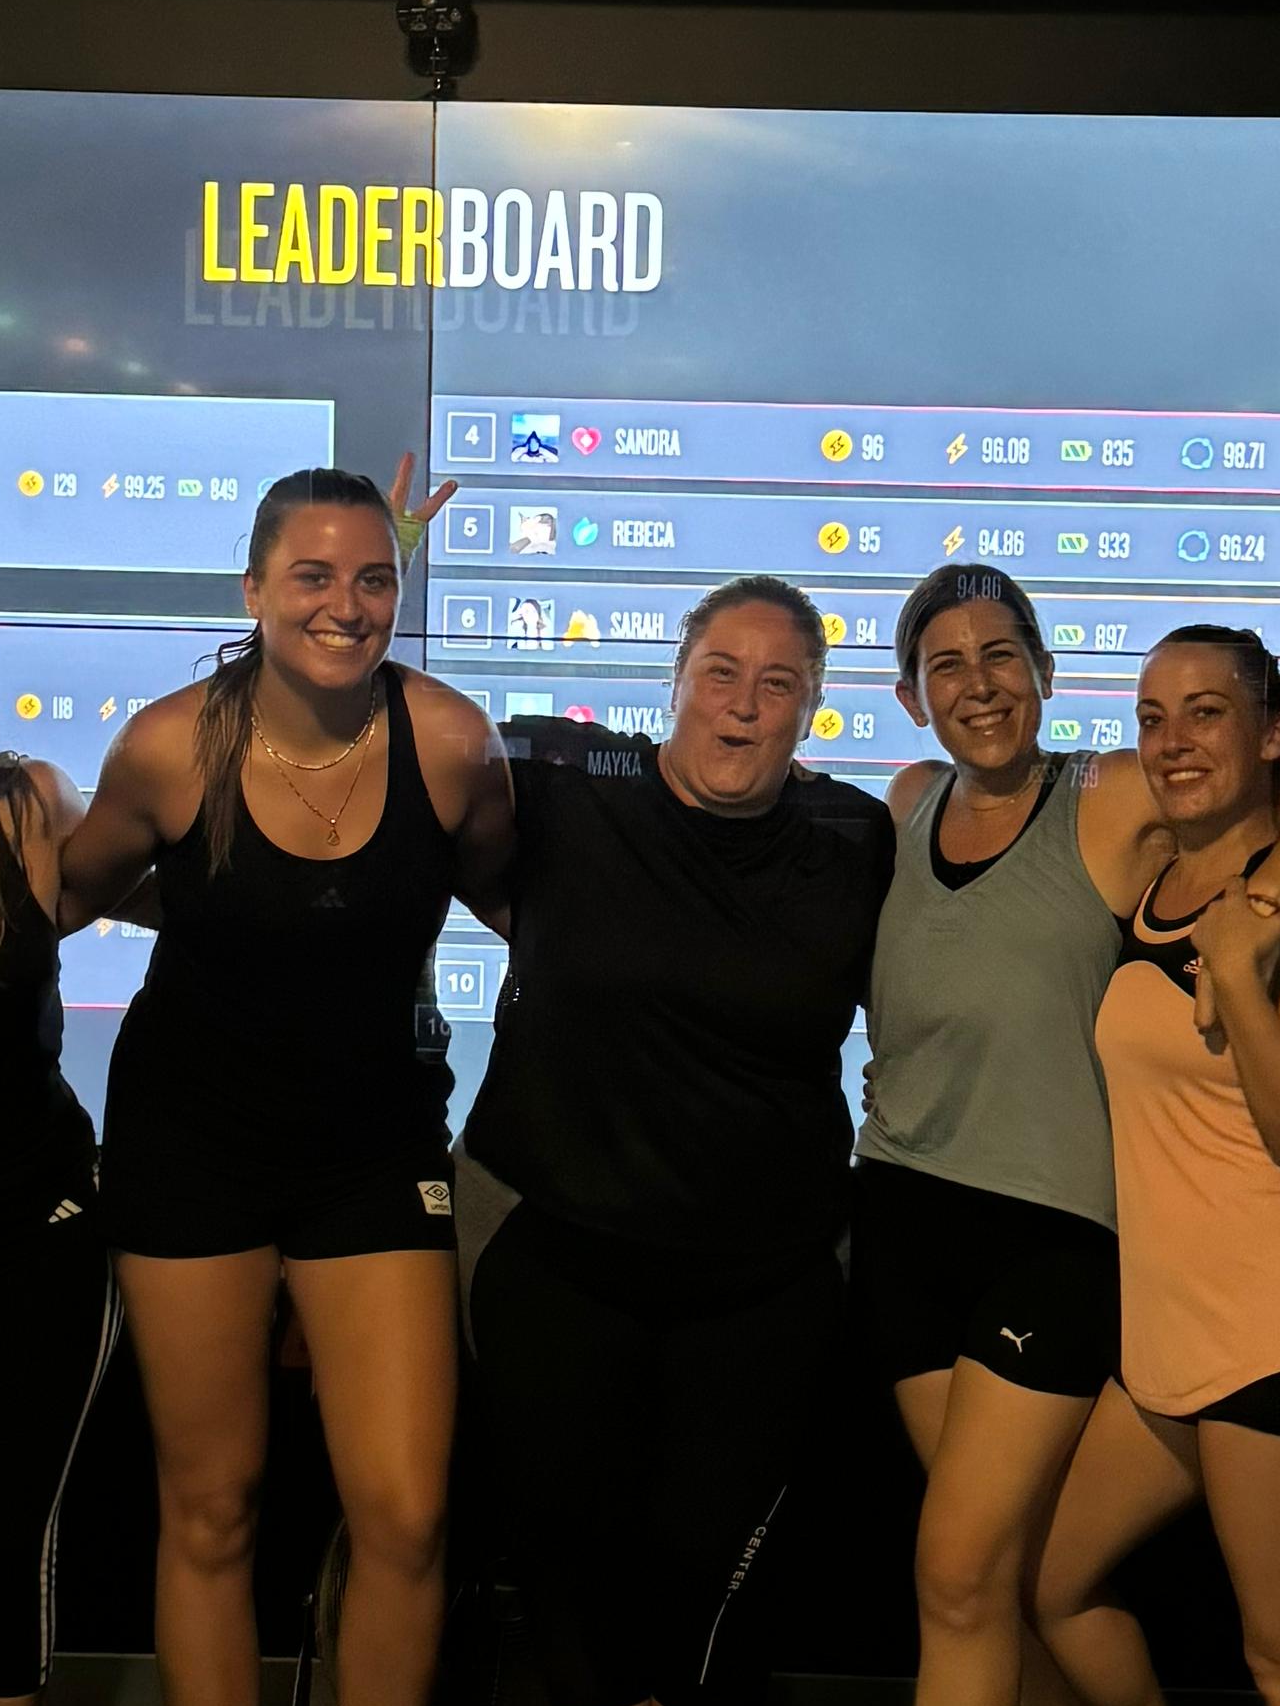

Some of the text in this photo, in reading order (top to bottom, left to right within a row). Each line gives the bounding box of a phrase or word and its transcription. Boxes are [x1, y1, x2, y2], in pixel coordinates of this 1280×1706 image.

[203, 181, 663, 292] LEADERBOARD
[464, 424, 1265, 469] 4 SANDRA 96 96.08 835 98.71
[53, 473, 77, 496] 129
[124, 475, 165, 499] 99.25
[210, 478, 238, 501] 849
[463, 517, 1265, 562] 5 REBECA 95 94.86 933 96.24
[461, 608, 476, 628] 6
[610, 611, 664, 640] SARAH
[1094, 624, 1128, 650] 897
[52, 696, 73, 720] 118
[607, 706, 1122, 746] MAYKA 93 759
[447, 973, 474, 993] 10
[728, 1526, 767, 1590] CENTER
